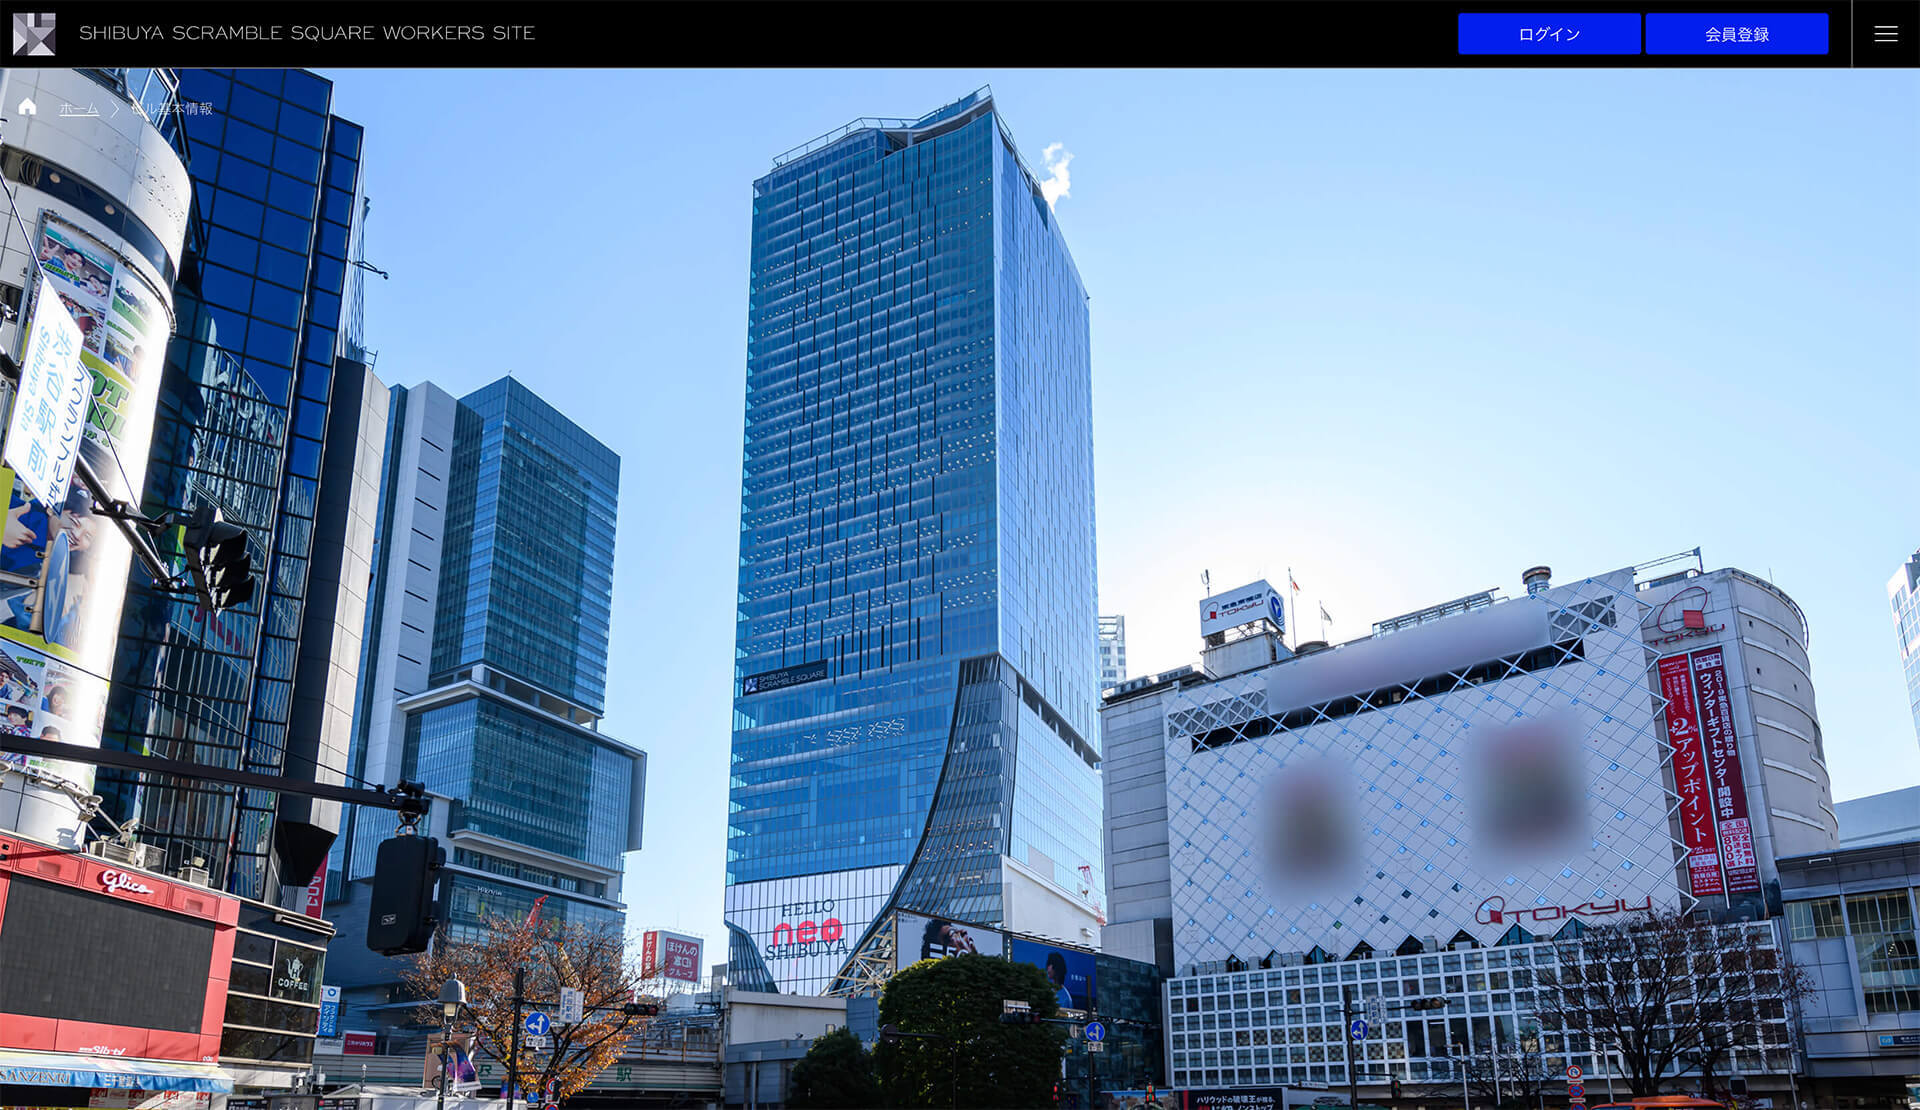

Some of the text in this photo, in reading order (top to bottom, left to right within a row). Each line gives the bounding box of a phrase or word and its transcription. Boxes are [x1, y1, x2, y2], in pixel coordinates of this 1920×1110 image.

[103, 870, 154, 893] Glico
[782, 898, 835, 917] HELLO
[1504, 896, 1651, 923] TOKYU
[773, 918, 843, 949] neo
[765, 938, 849, 961] SHIBUYA
[278, 978, 309, 991] COFFEE
